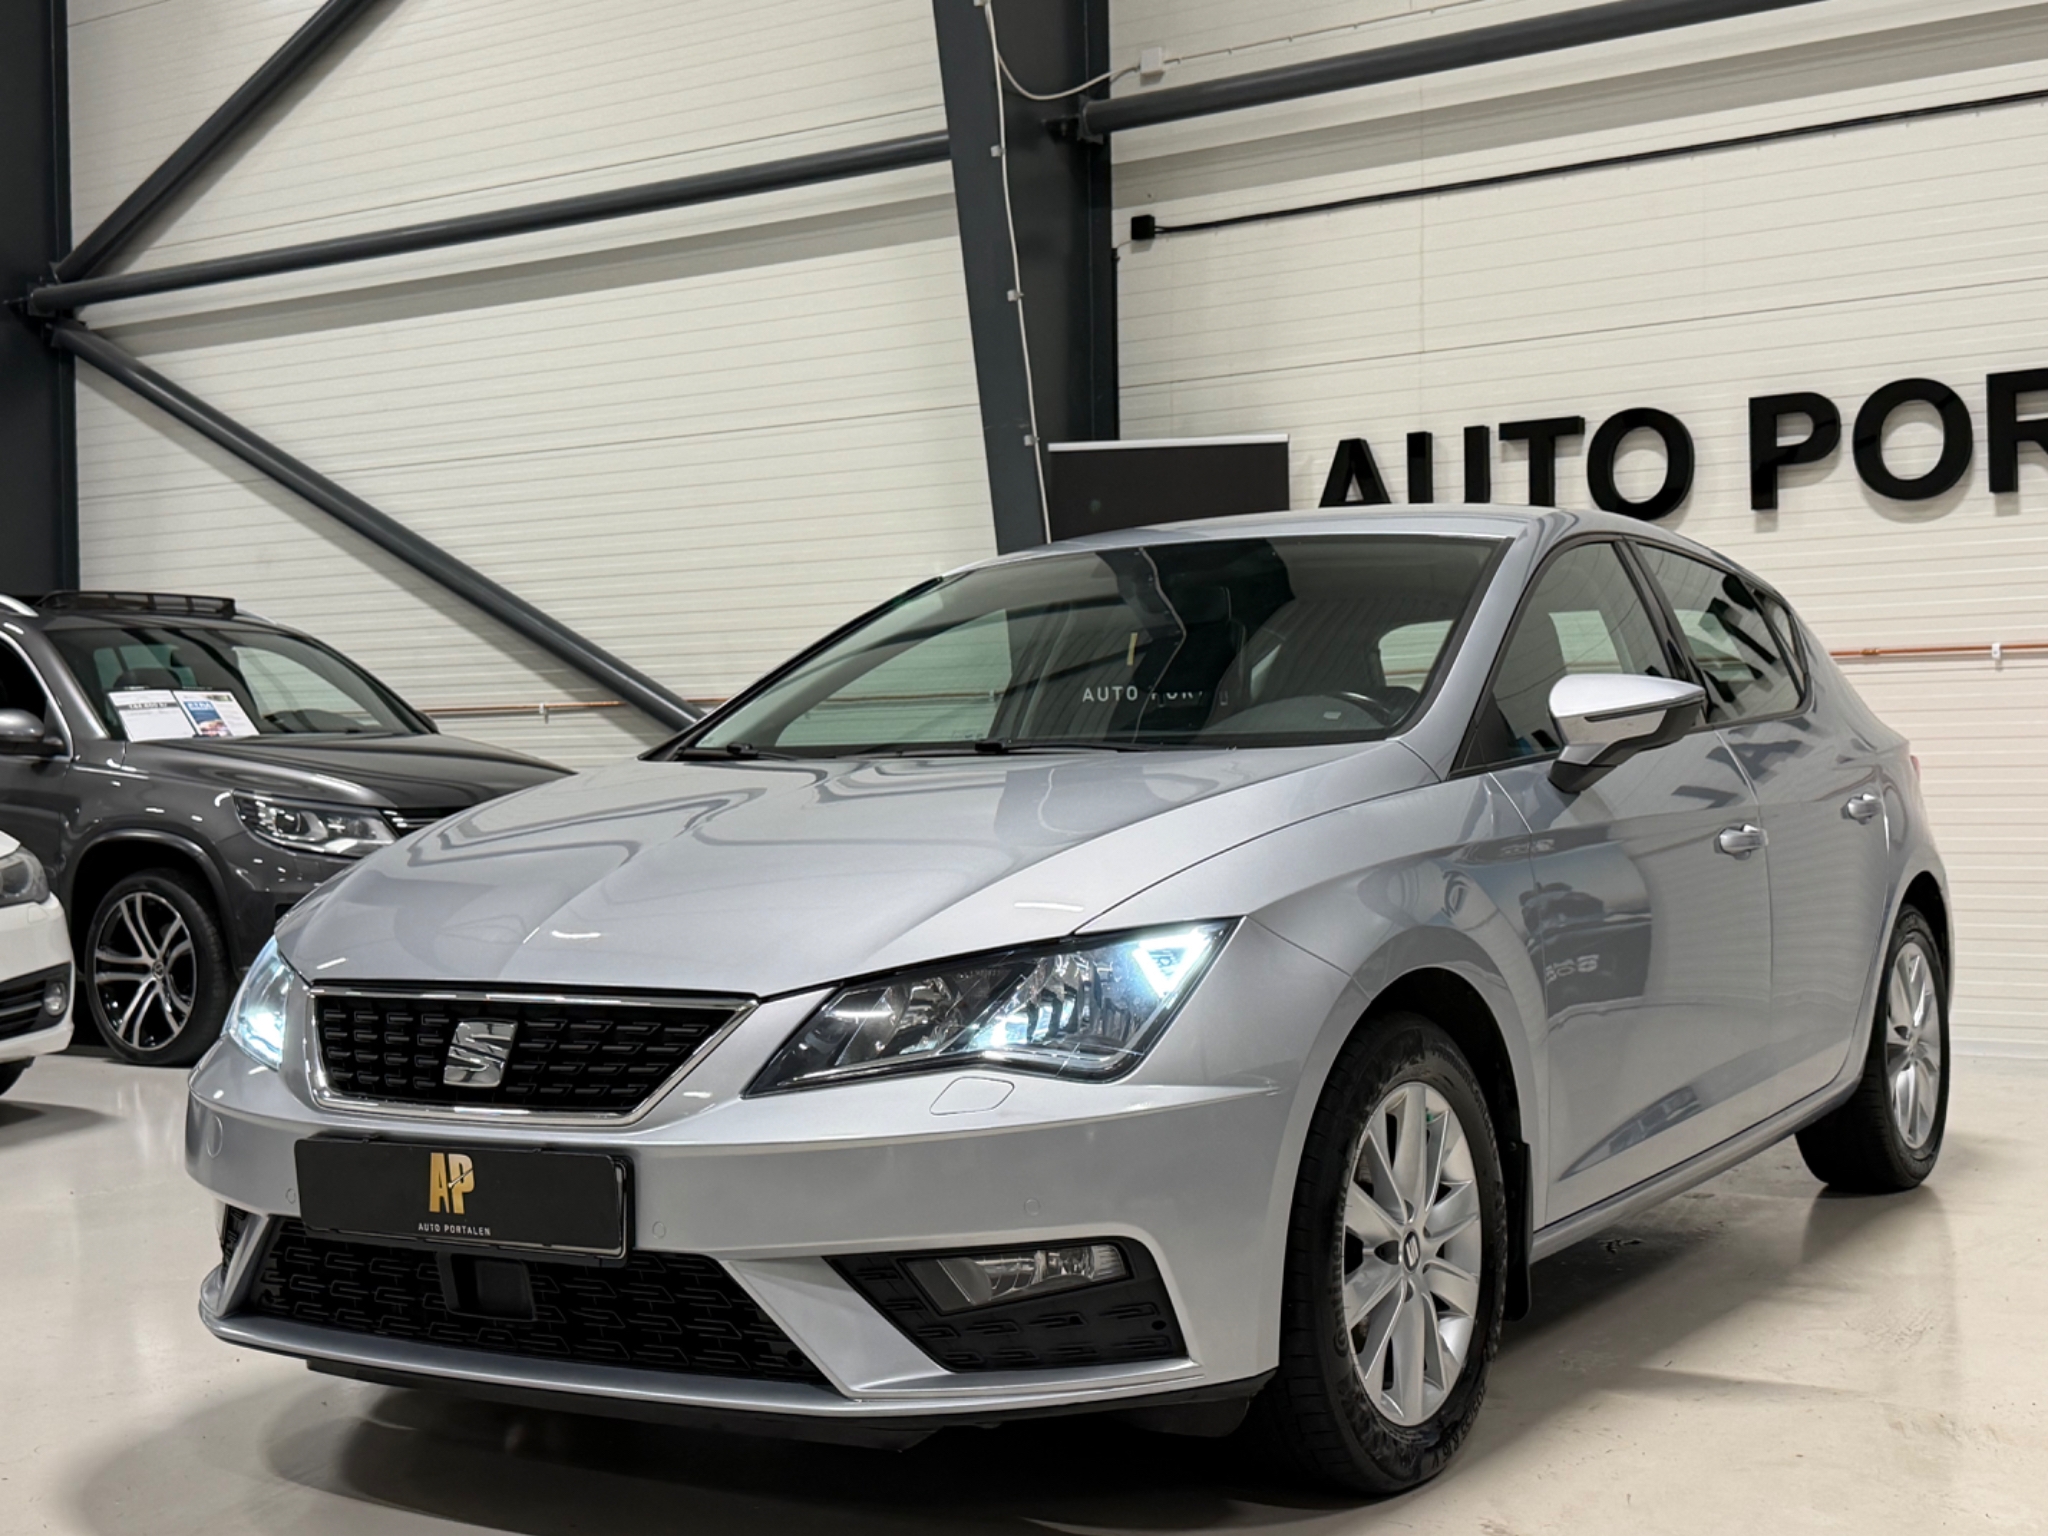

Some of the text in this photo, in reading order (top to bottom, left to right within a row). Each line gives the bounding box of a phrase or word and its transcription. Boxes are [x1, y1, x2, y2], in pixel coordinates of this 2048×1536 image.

[1318, 406, 1695, 521] AUTO
[1082, 686, 1138, 702] AUTO
[429, 1152, 475, 1215] AP
[418, 1222, 491, 1237] AUTO PORTALEN
